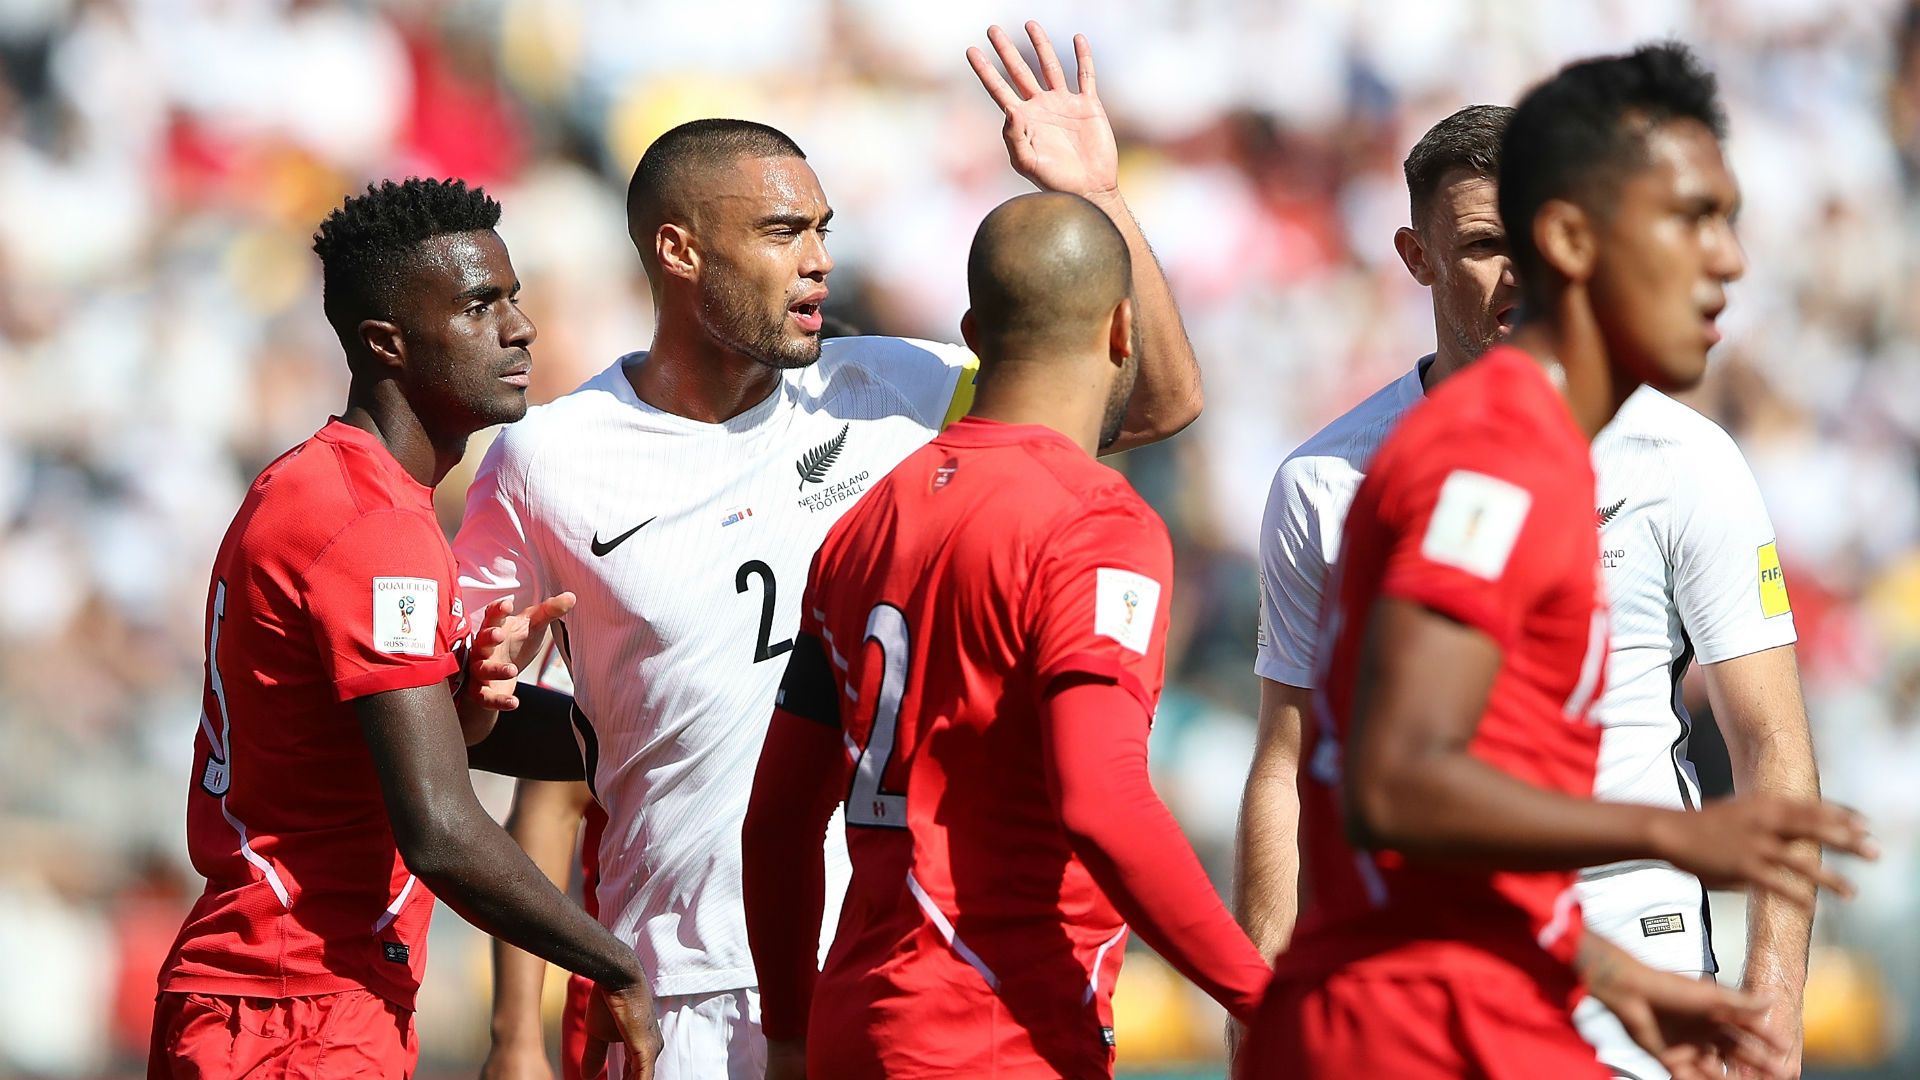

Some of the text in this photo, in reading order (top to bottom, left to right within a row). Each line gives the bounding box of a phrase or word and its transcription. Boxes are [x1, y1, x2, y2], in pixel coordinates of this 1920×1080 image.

[798, 470, 869, 507] NEW ZEALAND
[810, 485, 864, 513] FOOTBALL
[378, 581, 434, 592] QUALIFIERS
[735, 559, 794, 664] 2
[846, 602, 908, 828] 2
